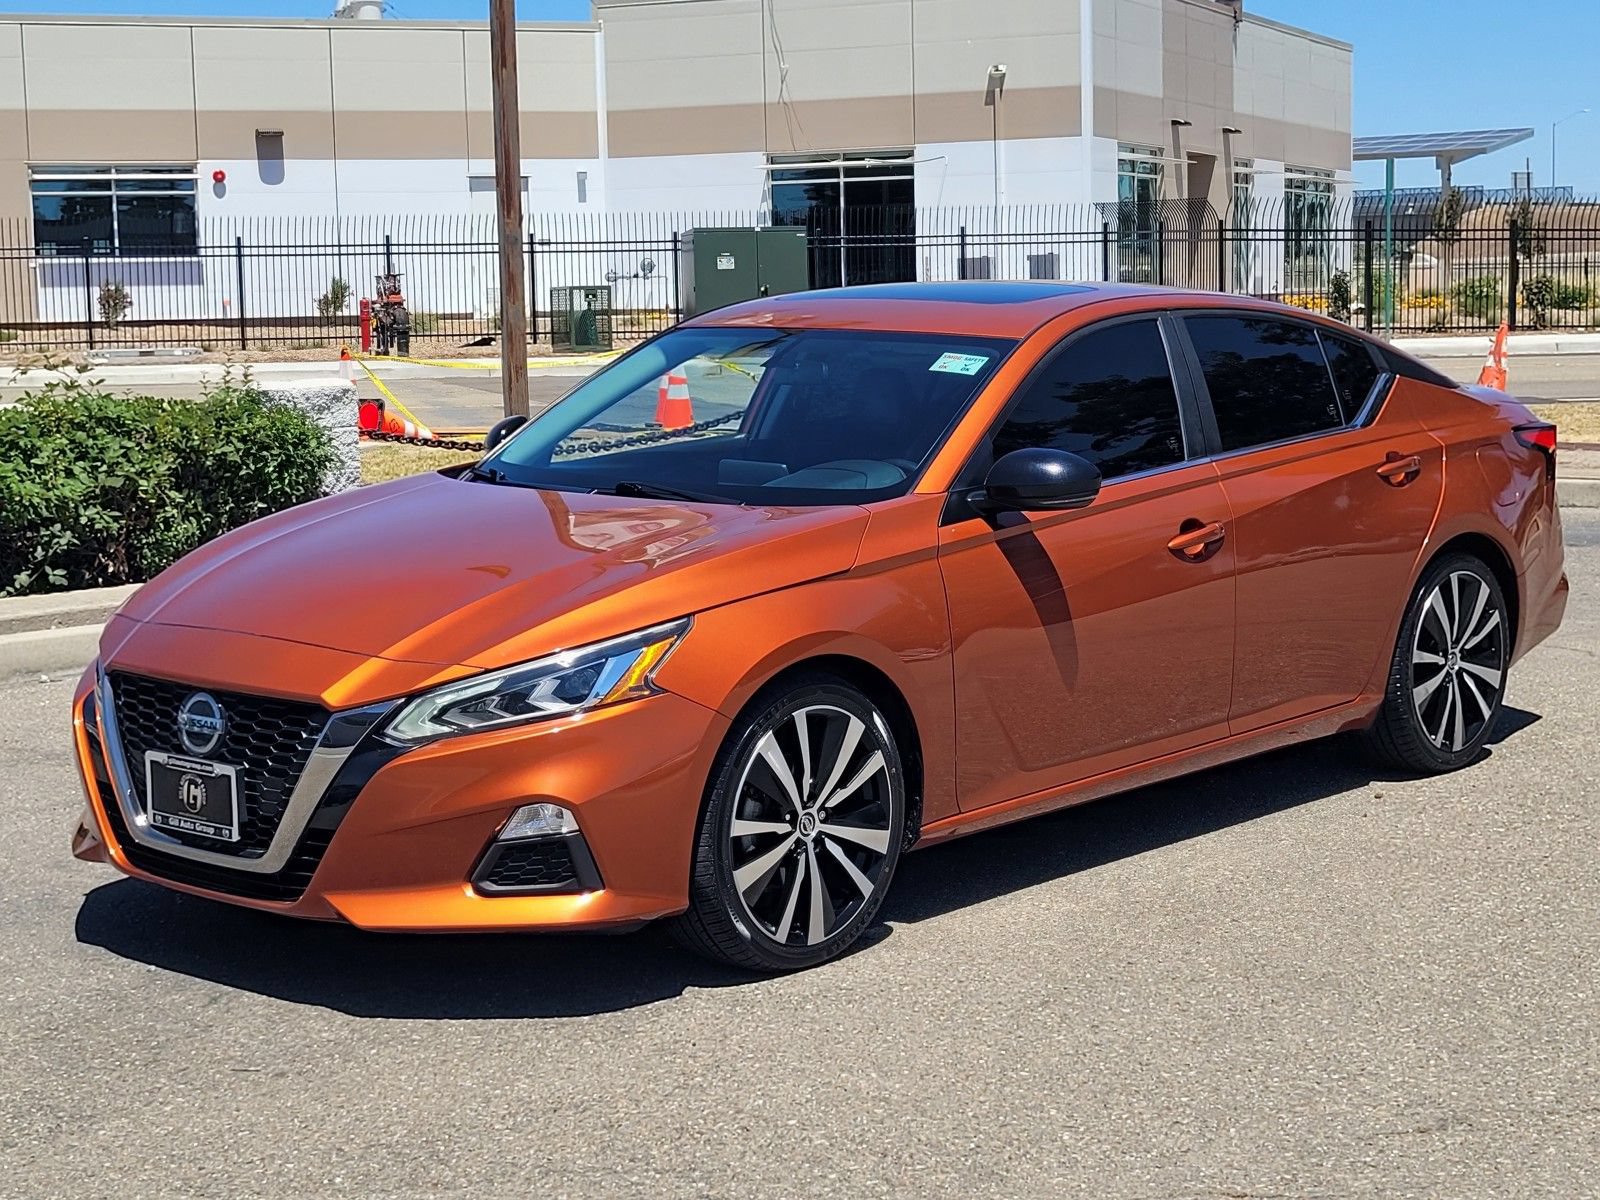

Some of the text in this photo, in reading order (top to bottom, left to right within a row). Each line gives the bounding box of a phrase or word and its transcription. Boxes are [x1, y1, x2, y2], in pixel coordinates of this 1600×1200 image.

[184, 718, 218, 730] ISSAN
[180, 820, 194, 830] Auto
[195, 823, 215, 835] Group
